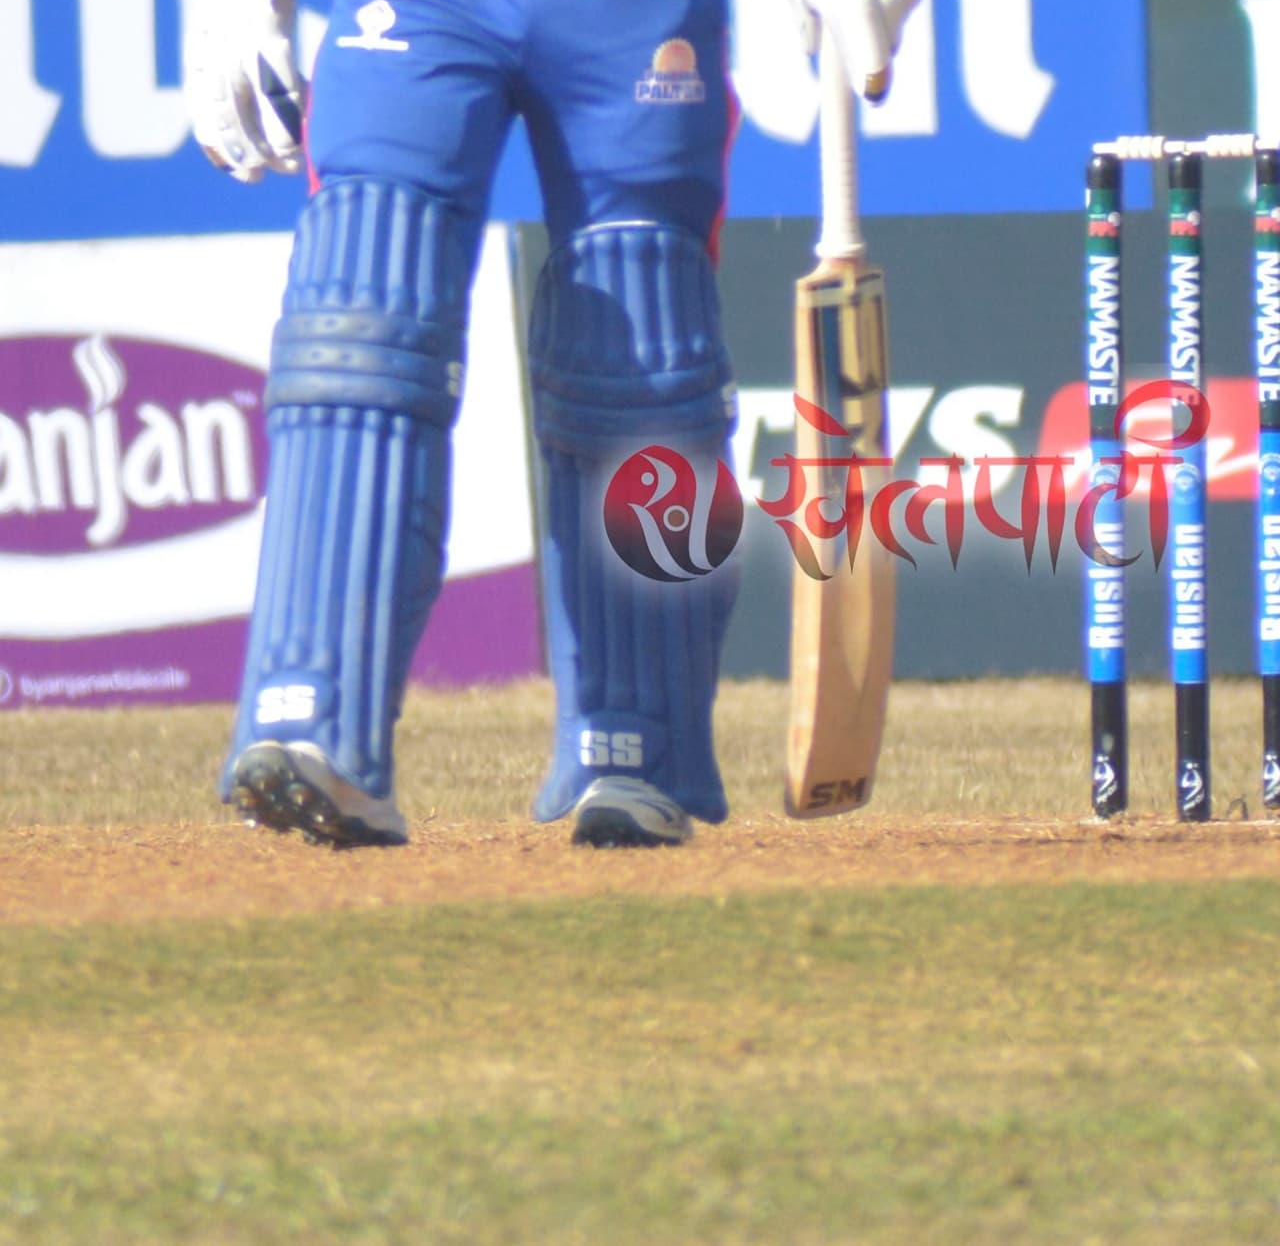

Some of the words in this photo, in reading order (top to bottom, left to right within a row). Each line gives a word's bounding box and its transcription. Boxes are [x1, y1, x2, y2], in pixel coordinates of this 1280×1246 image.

[1088, 256, 1120, 406] NAMASTE
[1170, 256, 1201, 406] NAMASTE
[1171, 523, 1207, 651] Ruslan
[257, 685, 316, 724] SS
[580, 729, 643, 767] SS
[806, 778, 867, 810] SM
